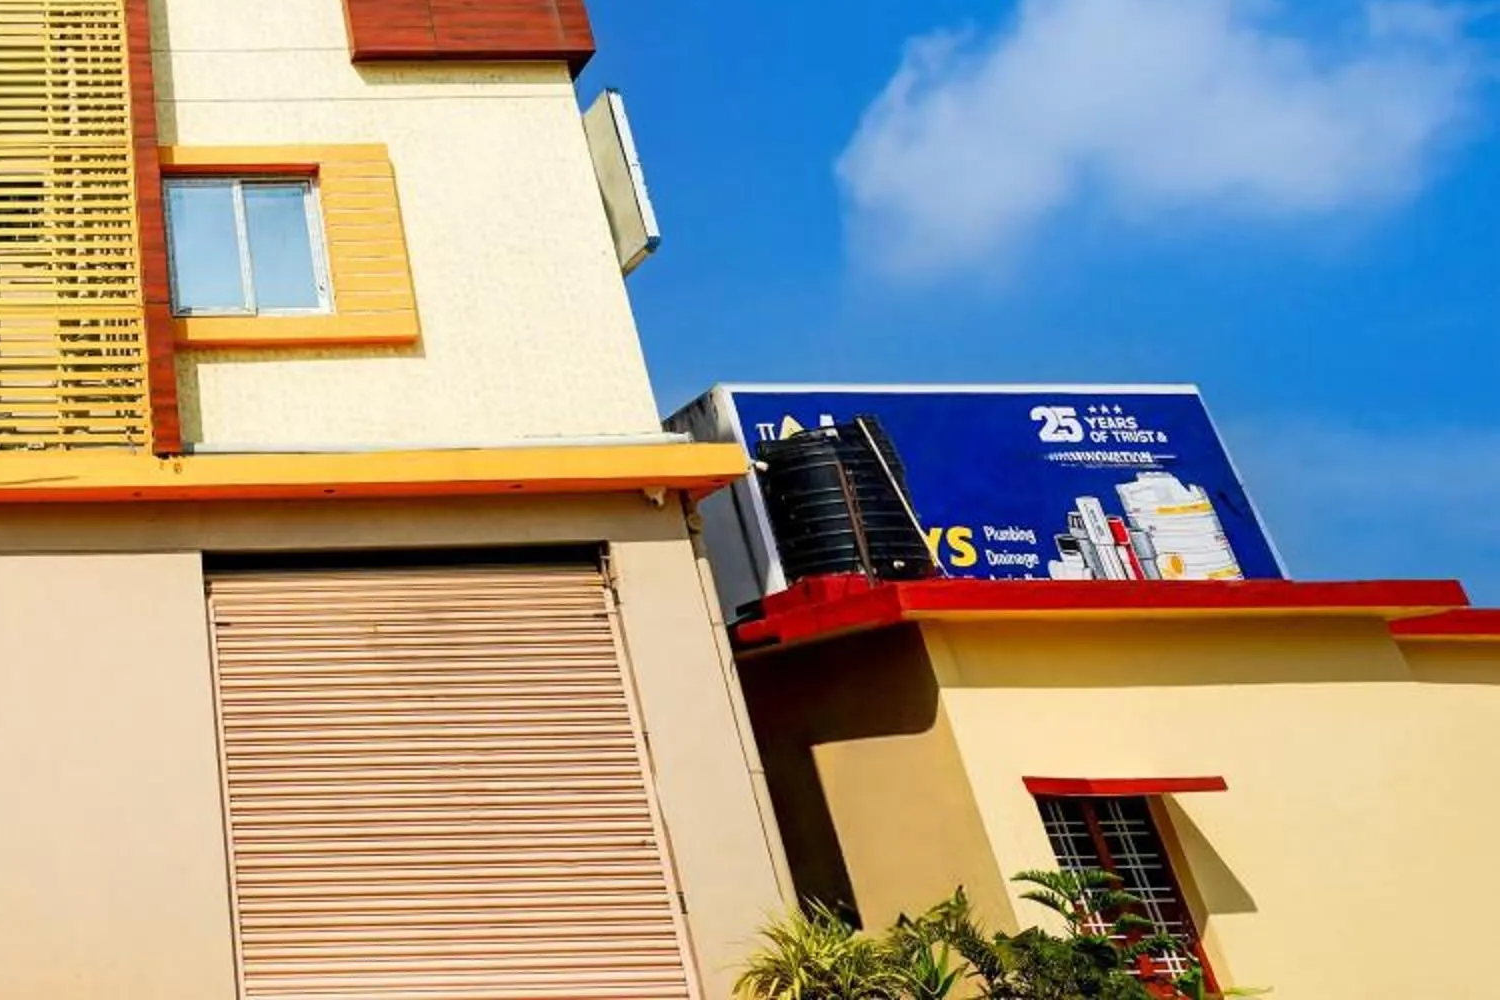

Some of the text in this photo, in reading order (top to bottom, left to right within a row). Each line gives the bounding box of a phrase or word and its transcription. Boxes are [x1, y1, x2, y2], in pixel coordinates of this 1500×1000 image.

[1030, 405, 1084, 443] 25
[1084, 415, 1139, 429] YEARS
[1089, 431, 1109, 443] OF
[1112, 430, 1155, 443] TRUST
[985, 548, 1039, 569] Drainage
